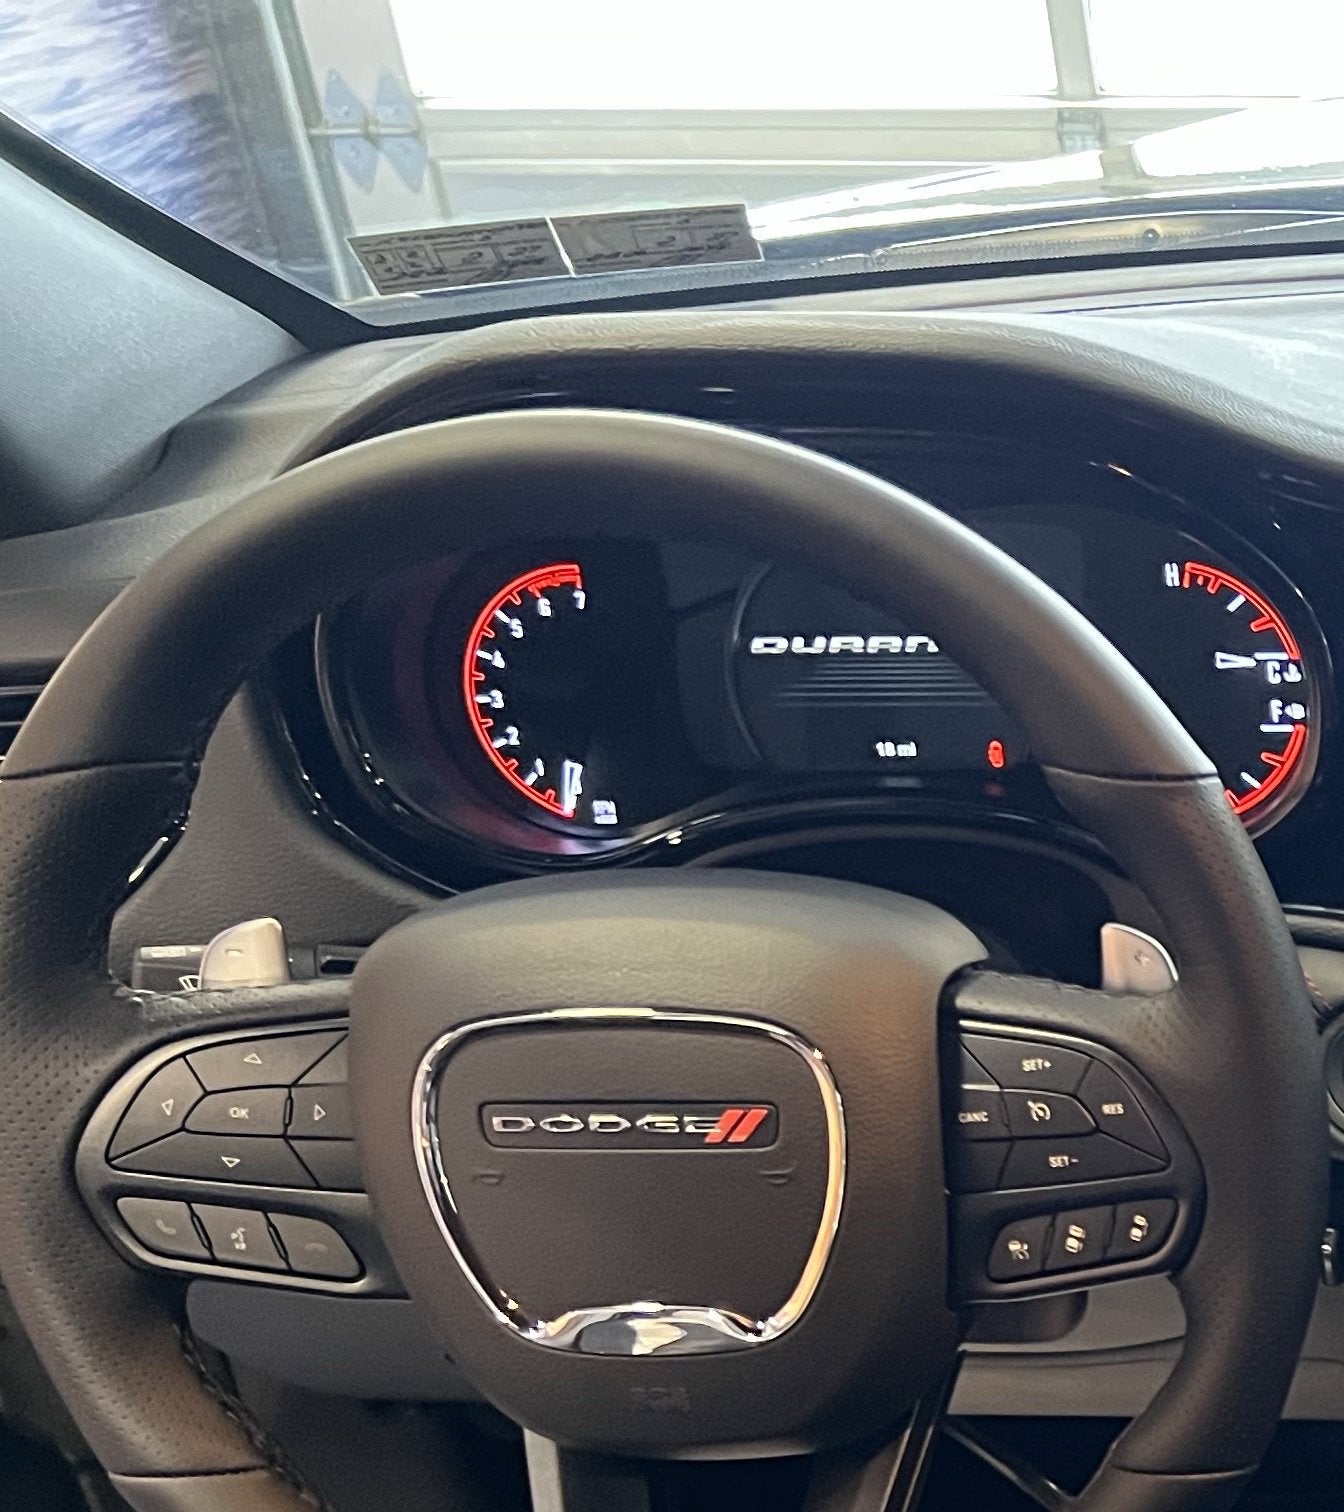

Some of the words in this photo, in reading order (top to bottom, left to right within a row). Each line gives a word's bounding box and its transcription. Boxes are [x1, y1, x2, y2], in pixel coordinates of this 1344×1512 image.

[1164, 563, 1180, 587] H
[537, 597, 553, 617] 6
[573, 589, 586, 610] 7
[509, 618, 524, 638] 5
[1266, 661, 1282, 685] C
[490, 689, 504, 709] 3
[1269, 698, 1283, 723] F
[505, 726, 520, 745] 2
[229, 1106, 250, 1120] OK
[1102, 1103, 1124, 1115] RES
[492, 1114, 722, 1133] DODGE
